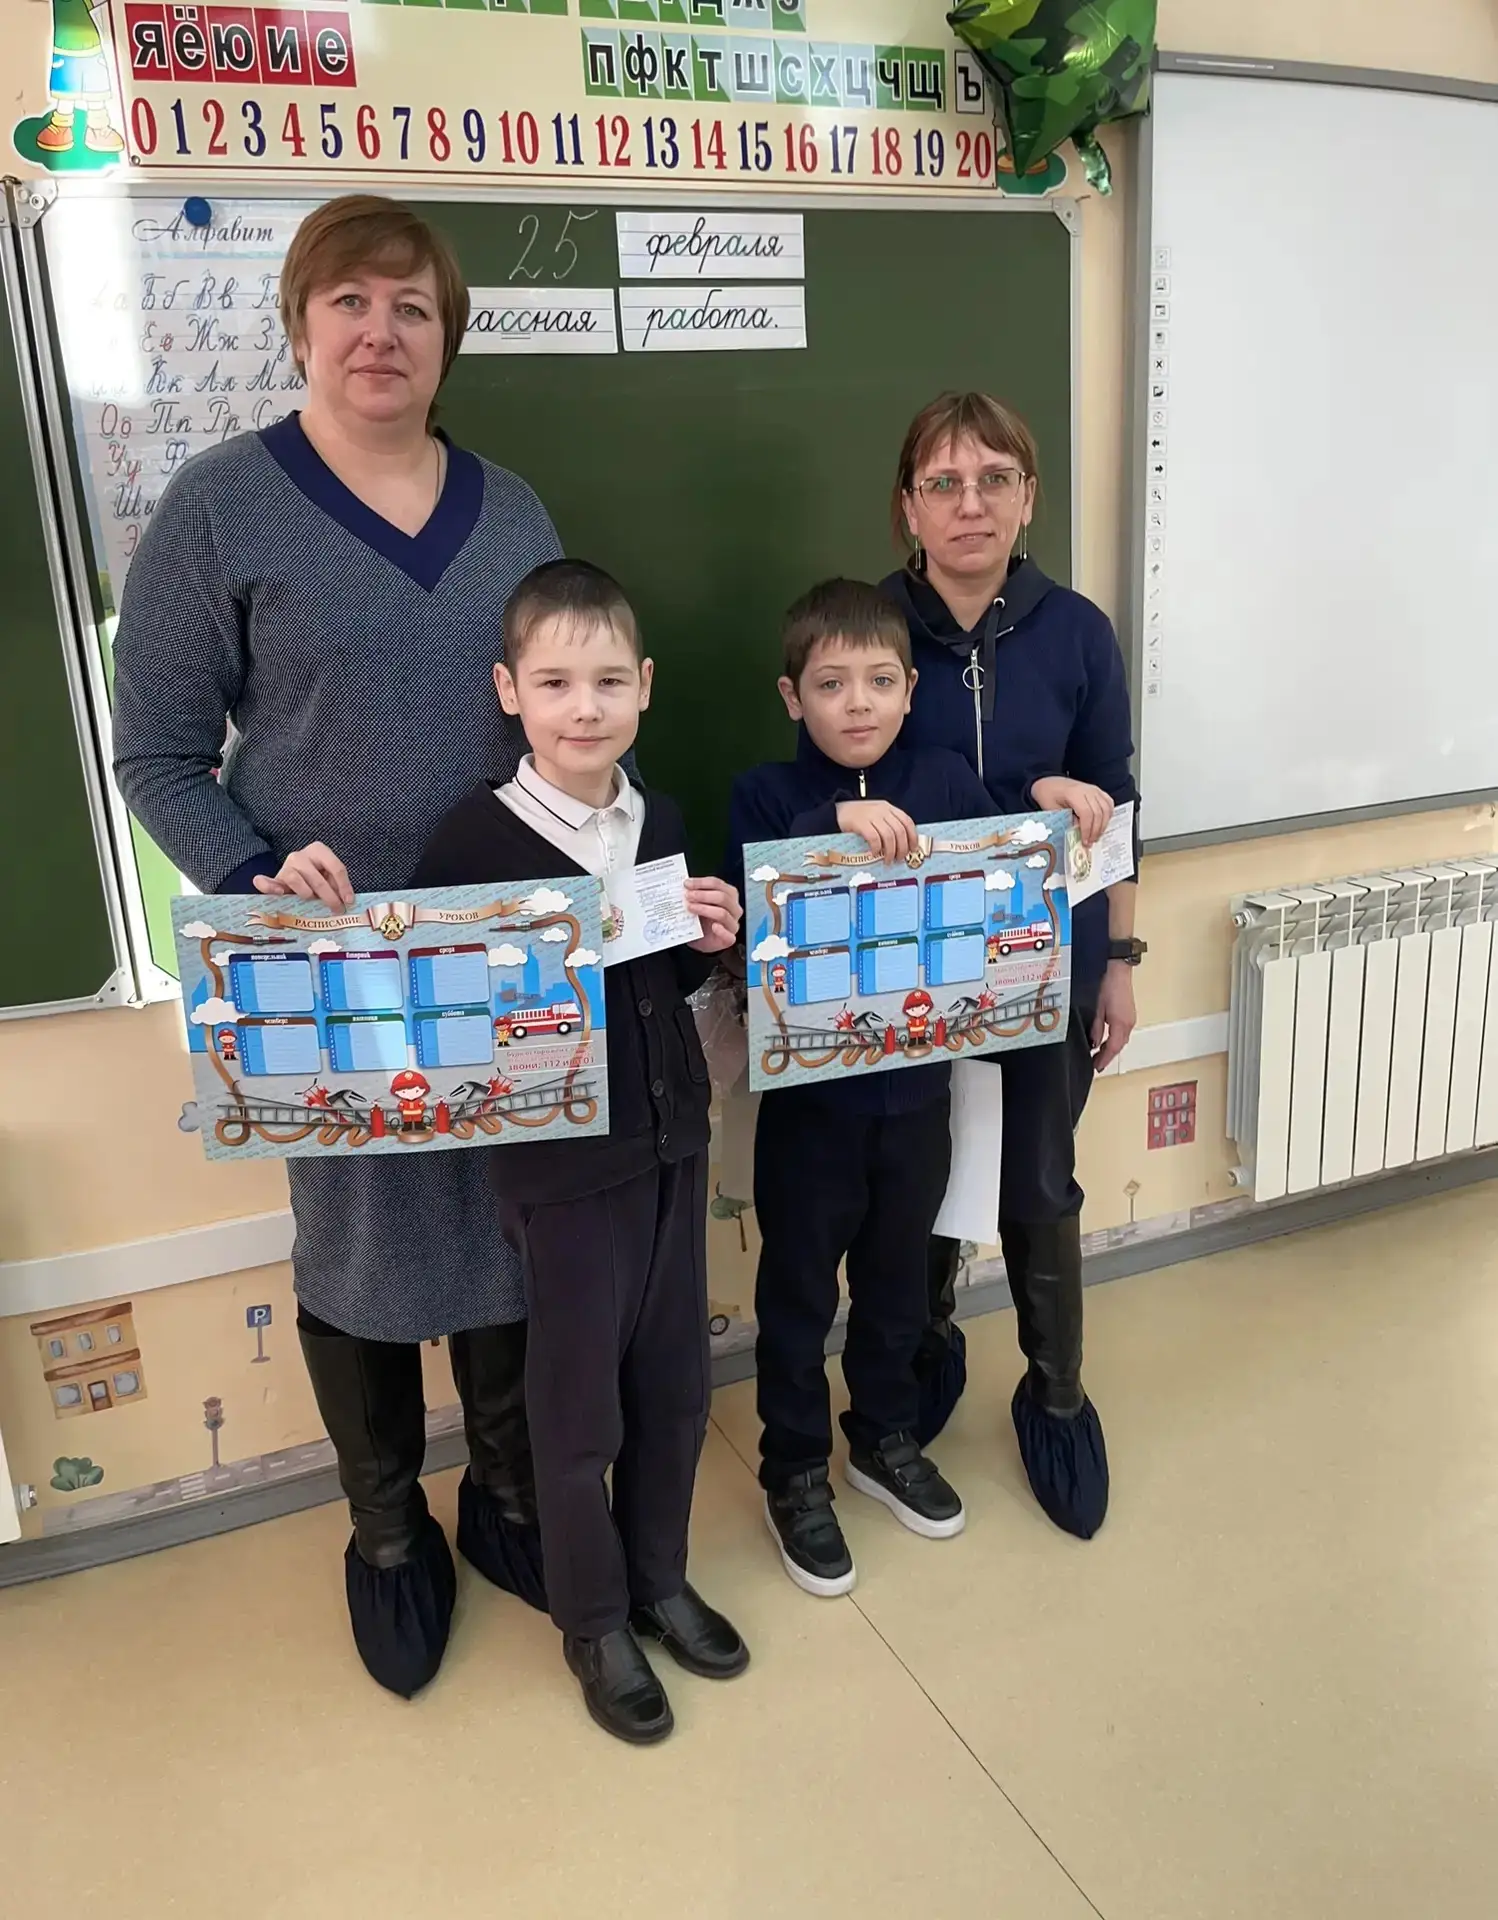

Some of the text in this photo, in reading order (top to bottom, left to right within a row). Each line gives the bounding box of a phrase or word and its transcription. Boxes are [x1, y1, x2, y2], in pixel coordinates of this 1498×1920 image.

[130, 97, 992, 179] 0 1 2 3 4 5 6 7 8 9 10 11 12 13 14 15 16 17 18 19 20
[509, 209, 598, 280] 25
[646, 216, 784, 273] февраля
[466, 310, 597, 332] ассная
[642, 289, 780, 347] работа.
[950, 842, 981, 852] УРОКОВ
[294, 910, 480, 928] РАСПИСАНИЕ УРОКОВ
[543, 1060, 560, 1068] 112
[254, 1308, 267, 1324] P
